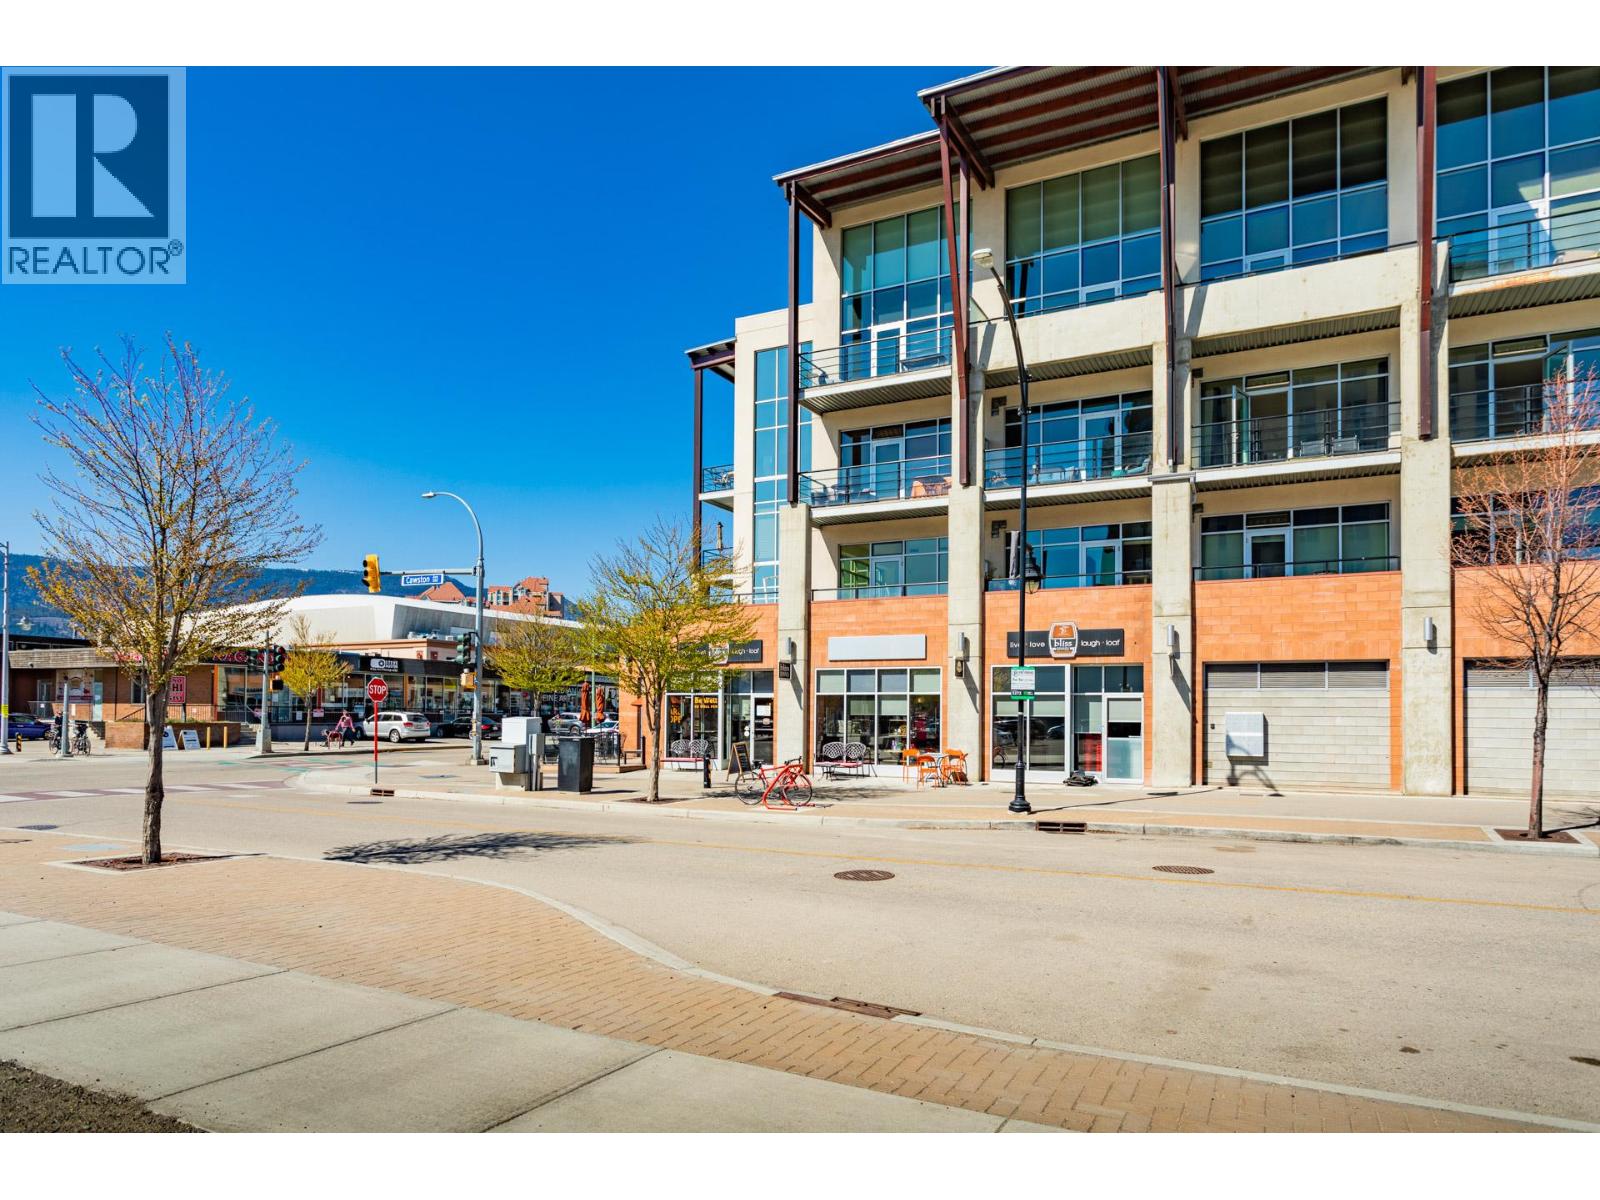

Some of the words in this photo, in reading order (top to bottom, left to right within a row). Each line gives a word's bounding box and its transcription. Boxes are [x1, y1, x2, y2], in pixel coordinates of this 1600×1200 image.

[406, 576, 430, 584] Cawston
[1054, 639, 1073, 647] bliss
[1080, 640, 1101, 648] laugh
[1105, 639, 1120, 647] loaf
[369, 684, 387, 695] STOP
